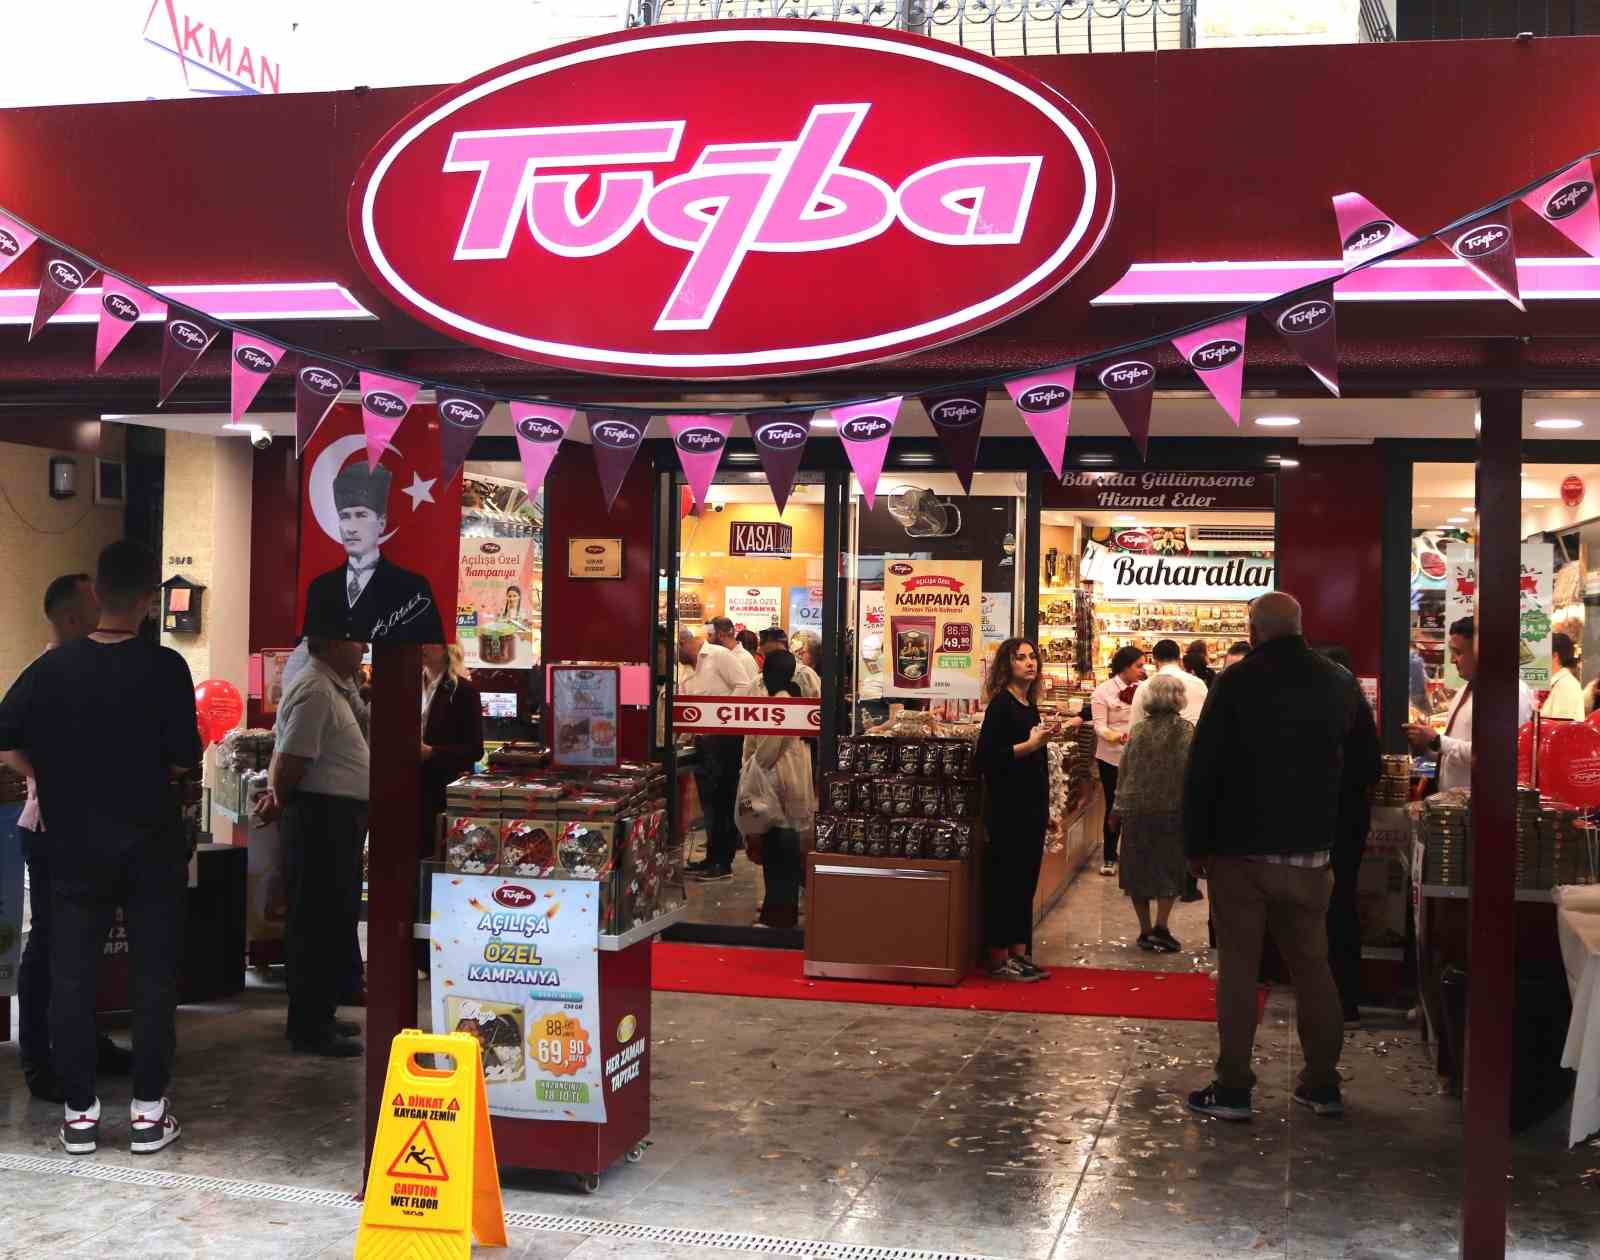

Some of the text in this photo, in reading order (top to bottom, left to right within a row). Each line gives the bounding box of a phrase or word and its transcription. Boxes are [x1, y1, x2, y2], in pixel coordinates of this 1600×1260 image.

[1141, 471, 1256, 490] Gülümseme
[1097, 491, 1217, 507] Hizmet Eder
[735, 525, 774, 551] KASA
[464, 566, 516, 580] Kampanya
[1112, 556, 1275, 587] Baharatlar
[895, 593, 970, 606] KAMPANYA
[716, 706, 786, 726] ÇIKIŞ
[477, 913, 550, 938] AÇILIŞA
[484, 937, 543, 965] ÖZEL
[467, 965, 561, 986] KAMPANYA
[605, 1036, 646, 1077] HER ZAMAN
[611, 1060, 641, 1093] TAPTAZE
[408, 1094, 444, 1109] DİKKAT
[393, 1107, 457, 1122] KAYGAN ZEMİN
[393, 1183, 438, 1197] CAUTION
[390, 1195, 439, 1210] WET FLOOR
